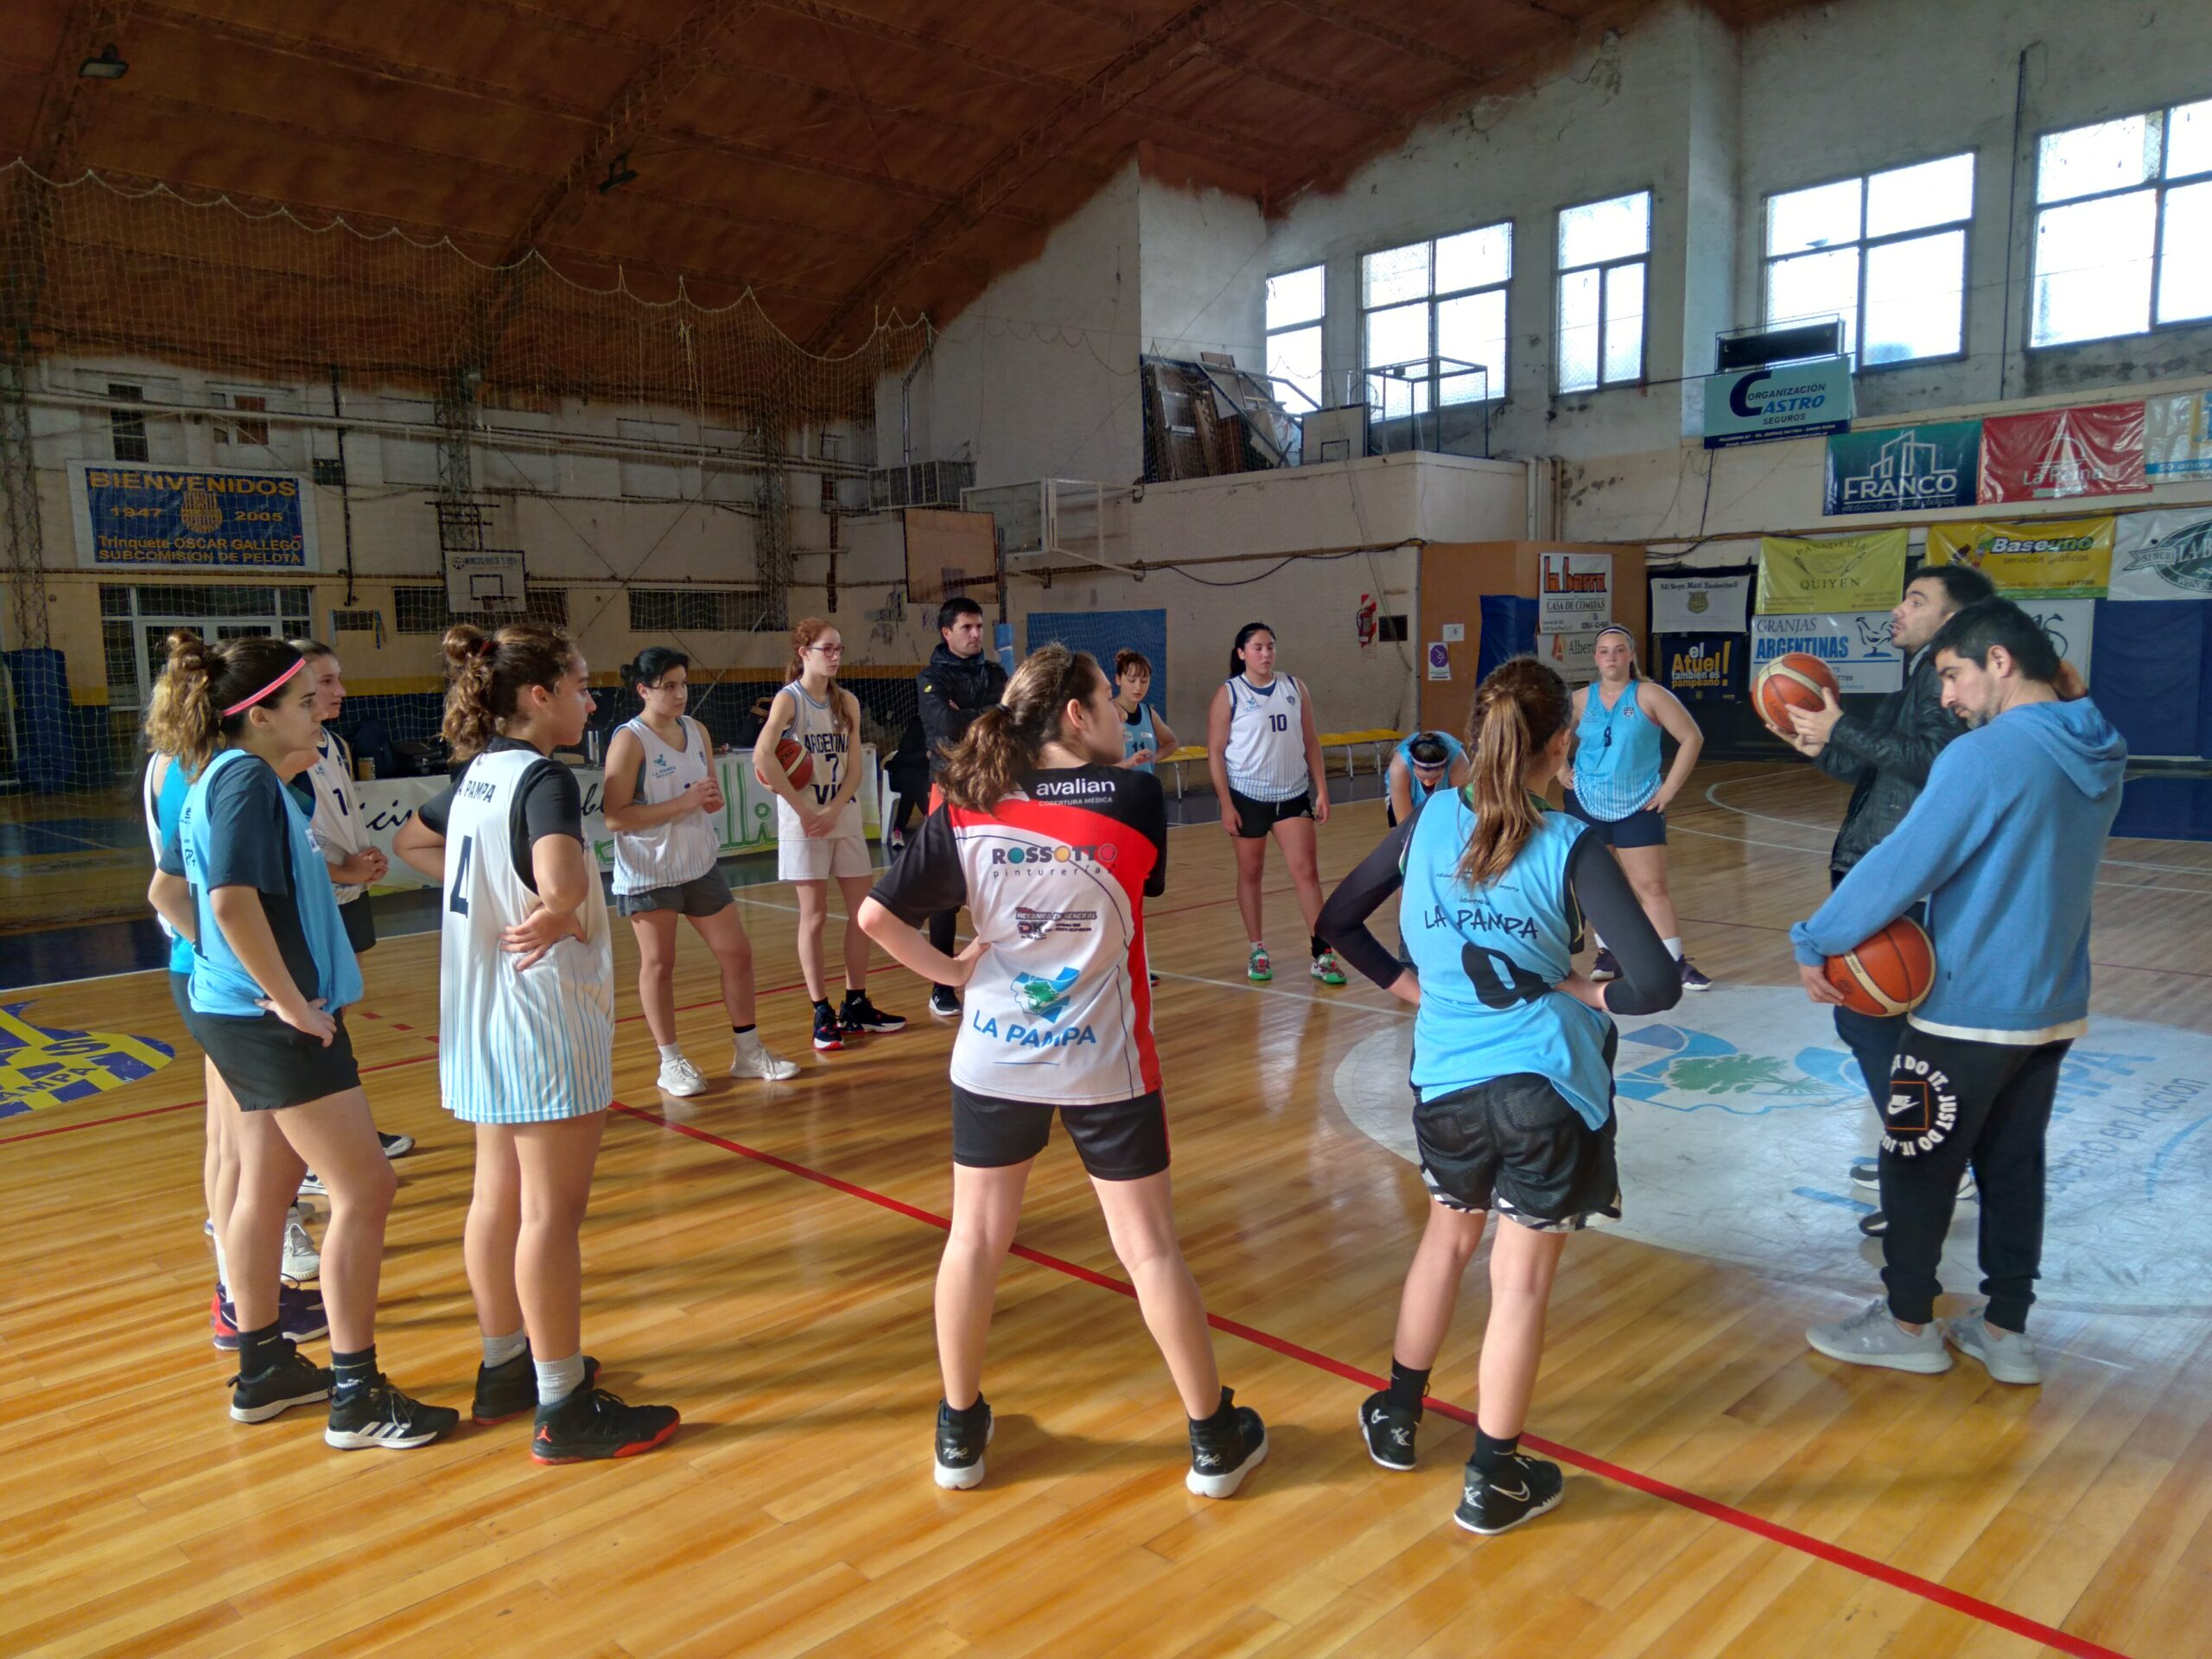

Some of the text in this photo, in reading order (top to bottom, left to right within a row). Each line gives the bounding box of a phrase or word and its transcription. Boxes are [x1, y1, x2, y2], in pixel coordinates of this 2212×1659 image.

[1763, 413, 1807, 425] SEGUROS
[89, 471, 296, 497] BIENVENIDOS
[1844, 474, 1958, 500] FRANCO
[2023, 471, 2044, 486] La
[110, 506, 162, 518] 1947
[234, 510, 283, 522] 2005
[174, 537, 227, 550] OSCAR
[232, 538, 302, 550] GALLEGO
[219, 551, 238, 563] DE
[243, 551, 301, 563] PELOTA
[2003, 554, 2045, 564] servicios
[2141, 552, 2172, 563] SINCE
[1800, 577, 1861, 591] QUIYEN
[1547, 601, 1564, 610] CASA
[1565, 601, 1573, 610] DE
[1757, 617, 1817, 634] GRANJAS
[1688, 642, 1705, 658] el
[1756, 635, 1849, 659] ARGENTINAS
[1672, 652, 1720, 674] Atuel
[1709, 671, 1720, 679] es
[1672, 679, 1719, 689] pampeano
[1268, 714, 1287, 733] 10
[804, 733, 849, 754] ARGENTIN
[824, 753, 839, 783] 7
[465, 780, 497, 804] PAMPA
[1036, 778, 1116, 796] avalian
[1038, 798, 1084, 807] COBERTURA
[992, 843, 1117, 865] ROSSOTTO
[1064, 911, 1097, 920] GENERAL
[1424, 905, 1447, 930] LA
[973, 1008, 1096, 1048] LA PAMPA
[1904, 1054, 1929, 1076] DO
[1934, 1095, 1958, 1131] JUST
[1918, 1128, 1945, 1151] DO
